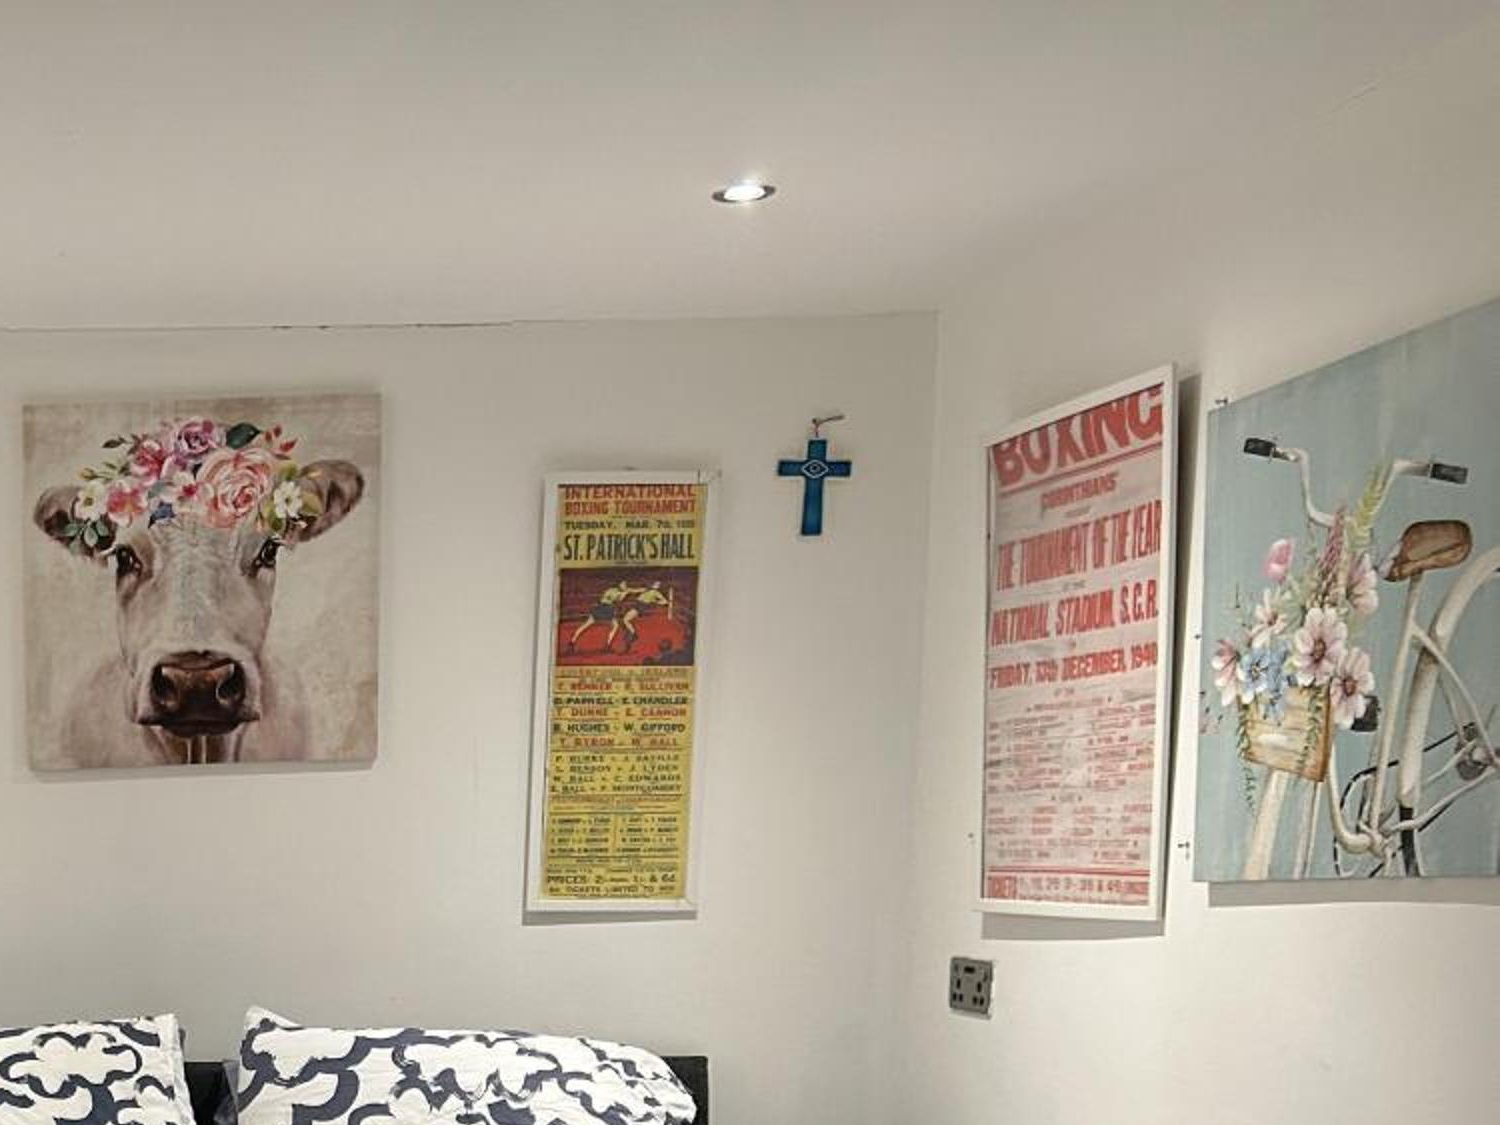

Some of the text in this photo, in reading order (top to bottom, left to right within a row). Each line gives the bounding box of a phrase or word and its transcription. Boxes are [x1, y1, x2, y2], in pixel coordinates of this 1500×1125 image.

[992, 383, 1163, 487] BOXING
[565, 484, 697, 499] INTERNATIONAL
[565, 499, 695, 516] BOXING TOURNAMENT
[1132, 499, 1162, 559] YEAR
[563, 532, 695, 560] ST. PATRICK'S HALL
[992, 602, 1050, 646] NATIONAL
[567, 723, 610, 733] HUGHES
